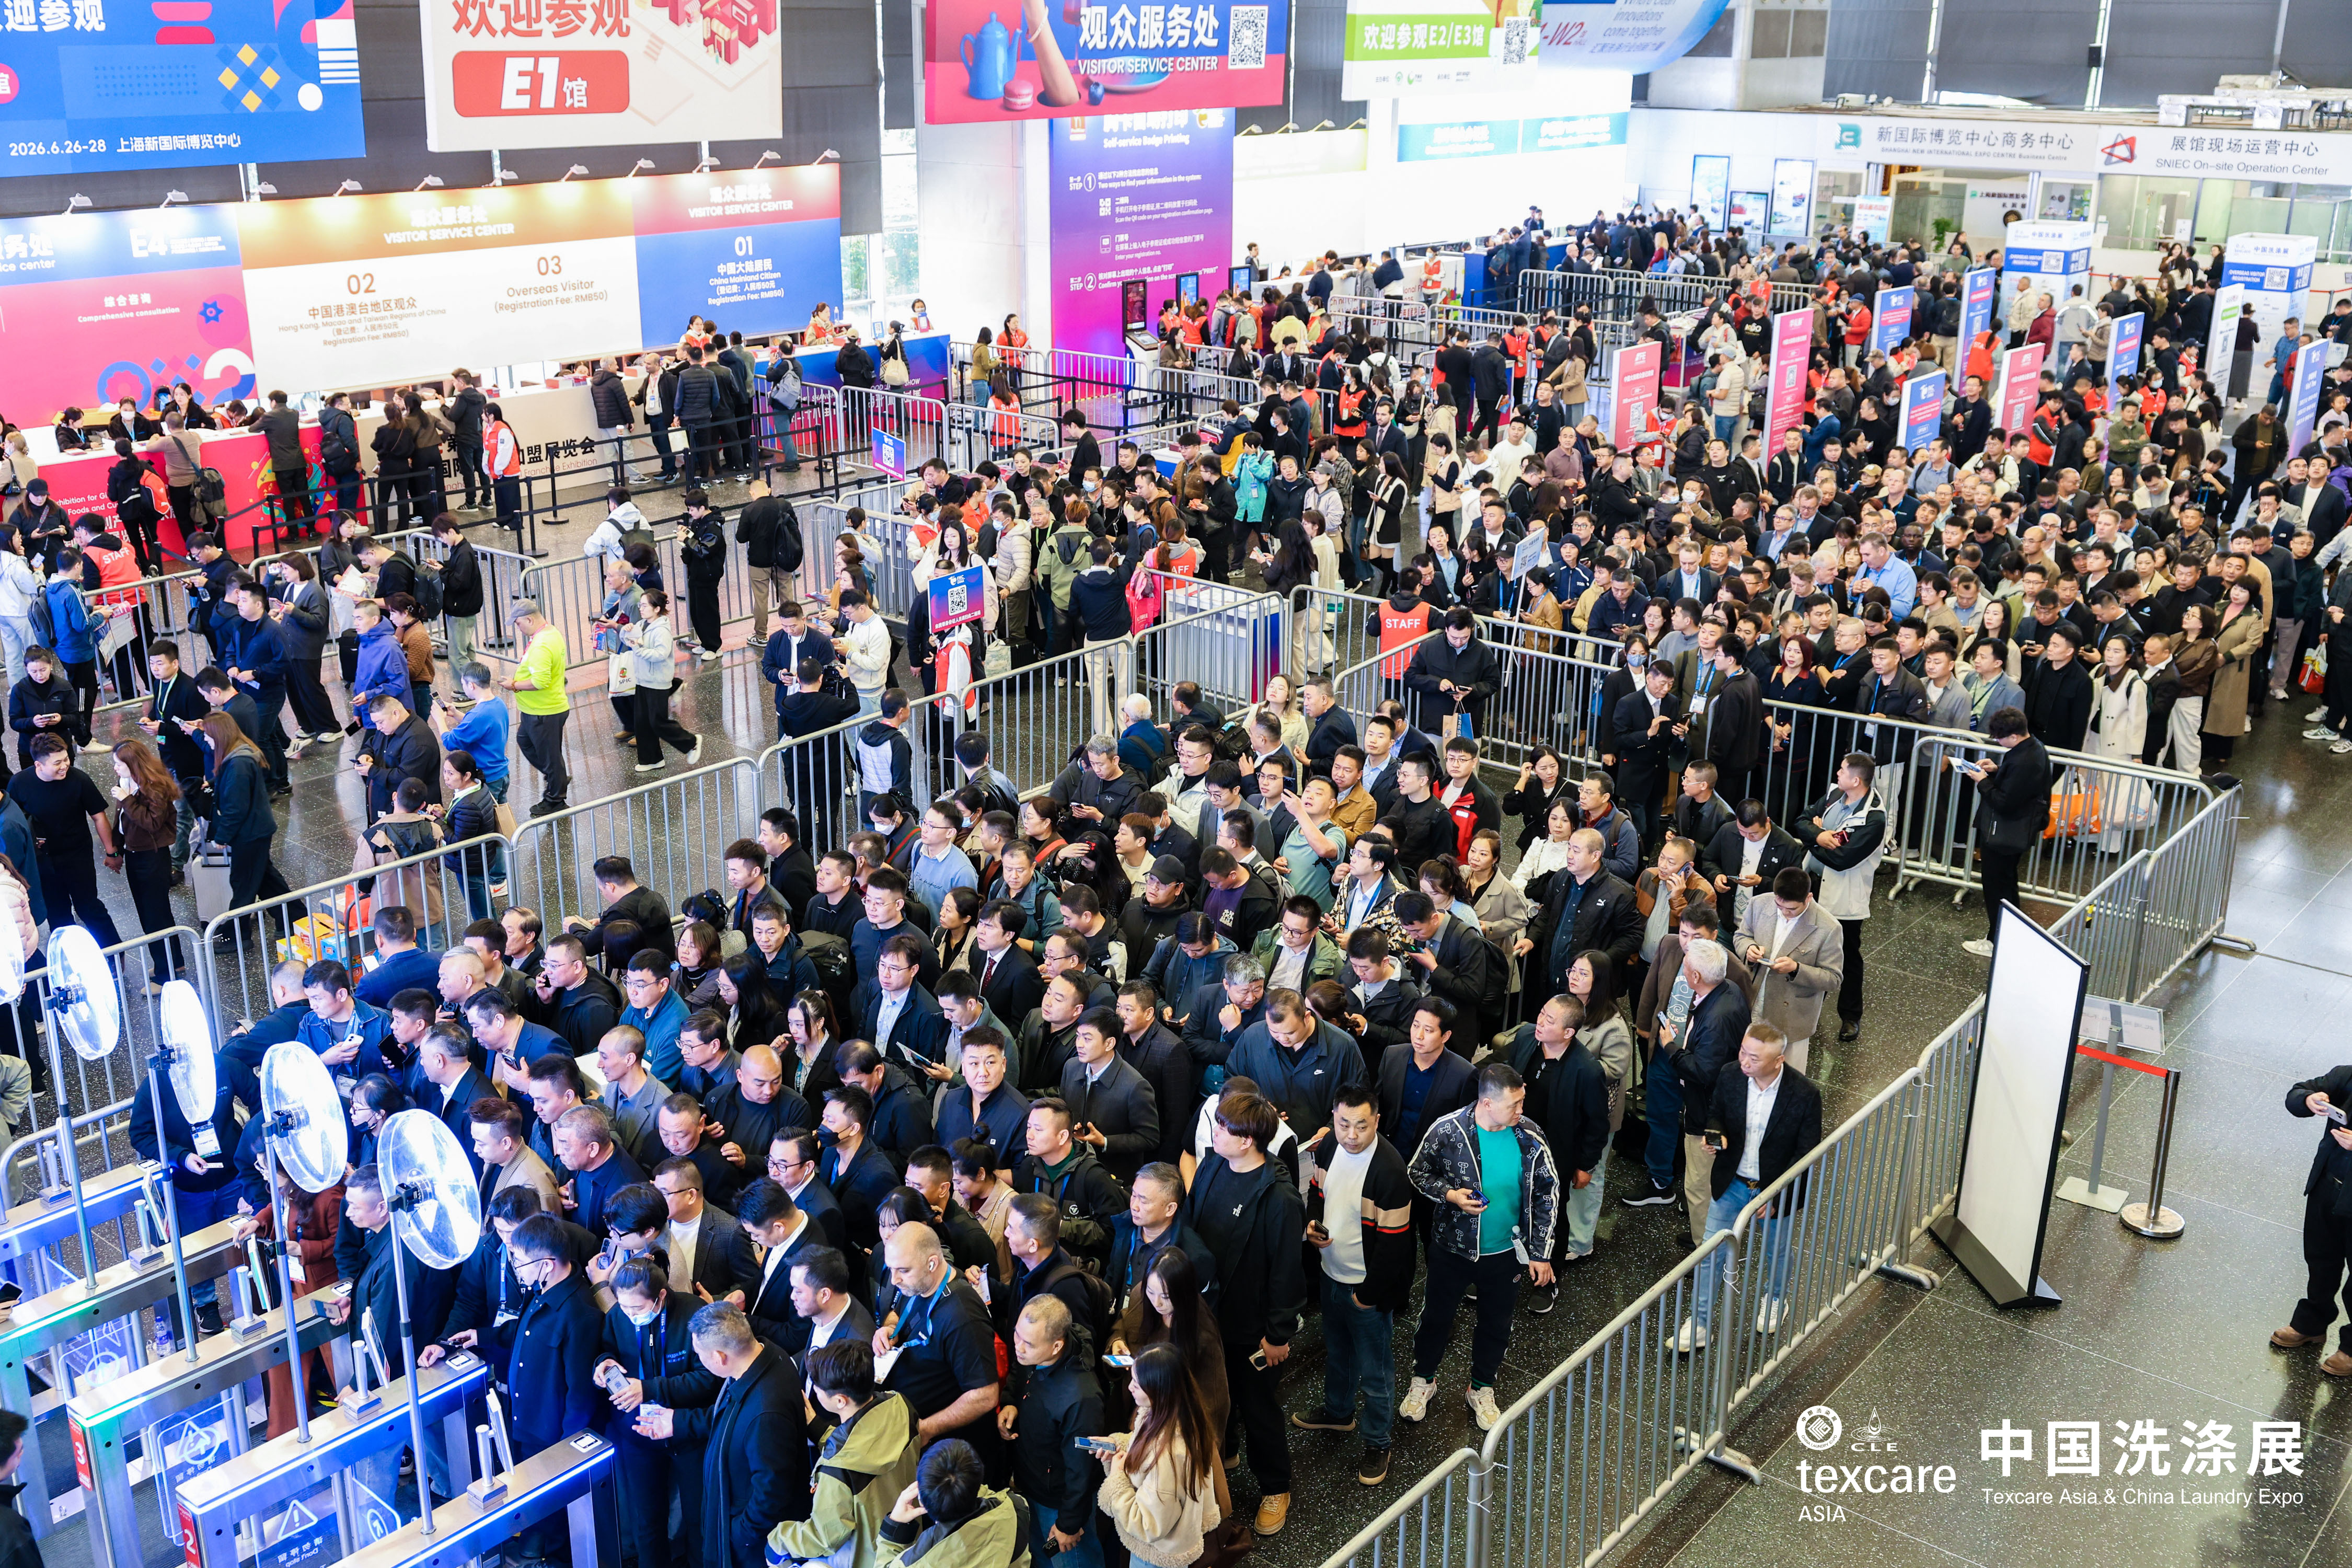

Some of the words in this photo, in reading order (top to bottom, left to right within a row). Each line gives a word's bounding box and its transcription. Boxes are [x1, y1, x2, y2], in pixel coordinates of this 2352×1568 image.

[0, 0, 106, 32] 迎参观
[1079, 3, 1219, 51] 观众服务处
[1079, 56, 1124, 75] VISITOR
[1127, 57, 1175, 73] SERVICE
[1177, 55, 1218, 72] CENTER
[117, 132, 241, 153] 上海新国际博览中心
[1877, 125, 2074, 151] 新国际博览中心商务中心
[2170, 135, 2320, 157] 展馆现场运营中心
[9, 139, 107, 156] 2026.6.26-28
[2156, 158, 2190, 169] SNIEC
[2237, 161, 2289, 175] Operation
[2292, 164, 2330, 176] Center
[688, 205, 723, 218] VISITOR
[724, 202, 760, 215] SERVICE
[761, 200, 793, 212] CENTER
[384, 230, 428, 244] VISITOR
[429, 226, 474, 240] SERVICE
[475, 223, 515, 237] CENTER
[0, 232, 54, 259] 务处
[129, 228, 168, 258] E4
[734, 236, 753, 257] 01
[20, 258, 56, 271] center
[537, 255, 562, 276] 03
[717, 258, 773, 276] 中国大陆居民
[347, 273, 376, 294] 02
[709, 277, 729, 286] China
[730, 273, 759, 283] Mainland
[760, 271, 781, 281] Citizen
[1070, 283, 1083, 292] STEP
[507, 282, 558, 297] Overseas
[560, 279, 594, 292] Visitor
[104, 292, 152, 307] 综合咨询
[555, 295, 574, 305] Fee:
[575, 290, 608, 304] RMB50)
[708, 293, 746, 307] Registration
[78, 309, 134, 322] Comprehensive
[135, 306, 180, 318] consultation
[308, 296, 417, 320] 中国港澳台地区观众
[279, 324, 298, 332] Hong
[321, 318, 345, 327] Macao
[348, 317, 362, 325] and
[363, 315, 388, 323] Taiwan
[389, 312, 417, 323] Regions
[425, 307, 446, 316] China
[323, 334, 366, 347] Registration
[367, 332, 382, 341] Fee:
[382, 329, 409, 340] RMB50)
[562, 458, 597, 470] Exhibition
[68, 505, 89, 515] Foods
[91, 504, 105, 512] and
[102, 547, 129, 564] STAFF
[1170, 565, 1190, 574] AFF
[1386, 618, 1421, 629] STAFF
[75, 1442, 86, 1465] 3
[184, 1528, 196, 1555] 2
